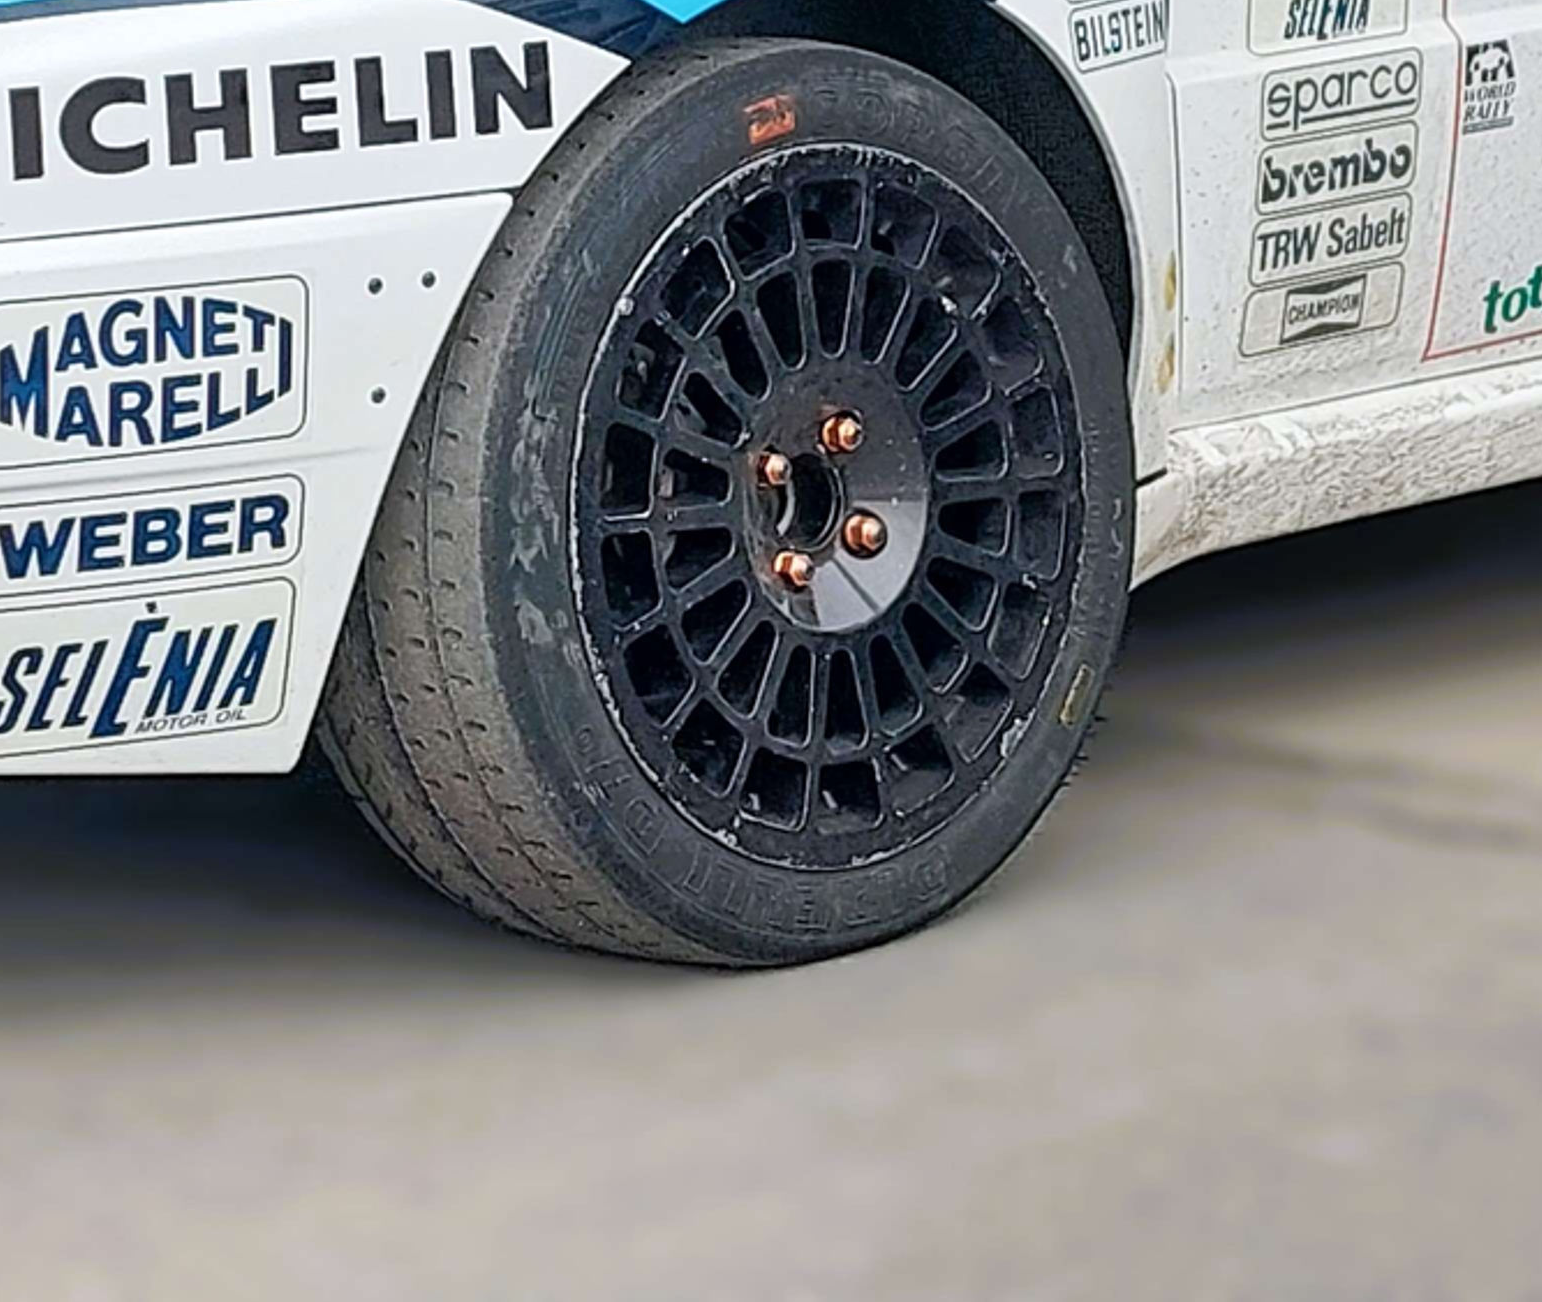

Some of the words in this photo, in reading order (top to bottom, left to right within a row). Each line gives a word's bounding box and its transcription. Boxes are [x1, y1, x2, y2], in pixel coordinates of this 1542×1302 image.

[1072, 0, 1166, 63] BILSTEIN
[1266, 60, 1419, 131] sparco
[1260, 137, 1413, 204] brembo
[1256, 220, 1323, 272] TRW
[1326, 206, 1406, 258] Sabelt
[1287, 293, 1360, 326] CHAMPION
[133, 712, 208, 734] MOTOR
[215, 708, 247, 724] OIL
